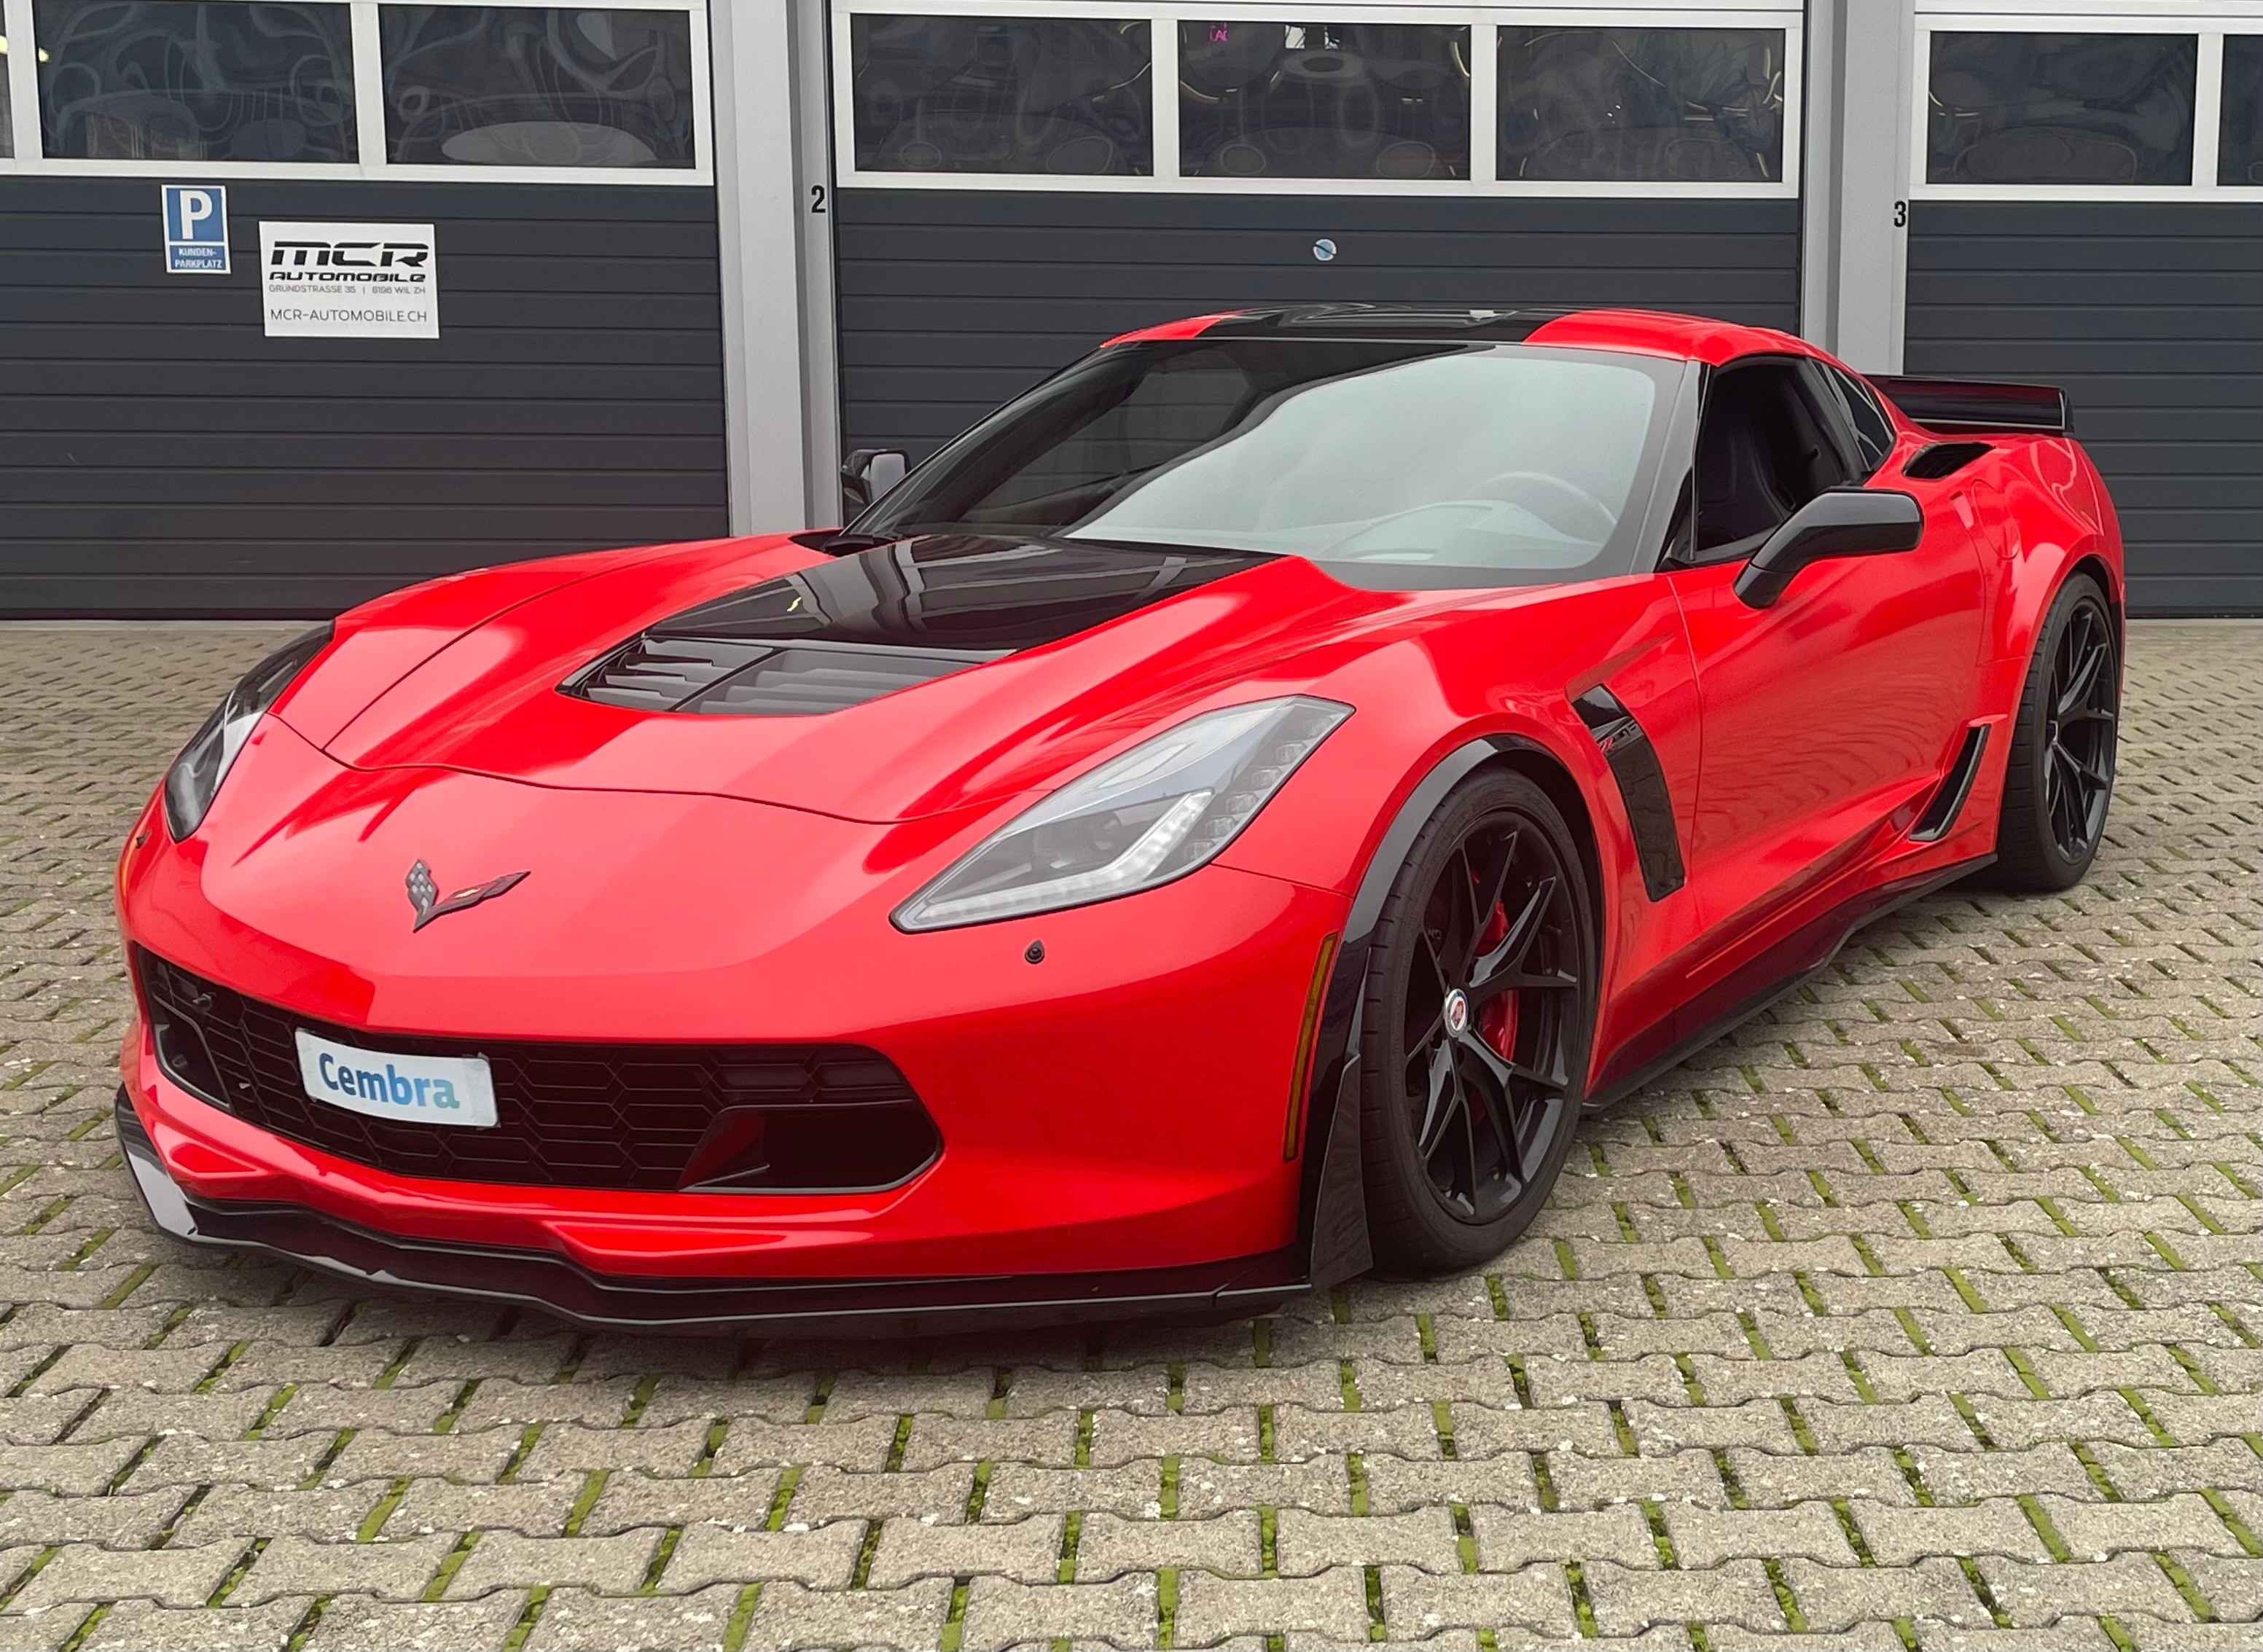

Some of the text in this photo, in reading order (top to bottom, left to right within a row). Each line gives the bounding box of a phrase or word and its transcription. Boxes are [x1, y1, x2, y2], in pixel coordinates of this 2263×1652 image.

[811, 184, 826, 214] 2
[179, 189, 213, 240] P
[1893, 200, 1907, 227] 3
[175, 259, 222, 269] PARKPLATZ
[179, 247, 217, 257] KUNDEN-
[270, 240, 429, 267] MCR
[268, 283, 343, 293] GRUNDSTRASSE
[413, 286, 426, 294] ZH
[269, 271, 426, 283] AUTOMOBILE
[318, 1052, 461, 1110] Cembra
